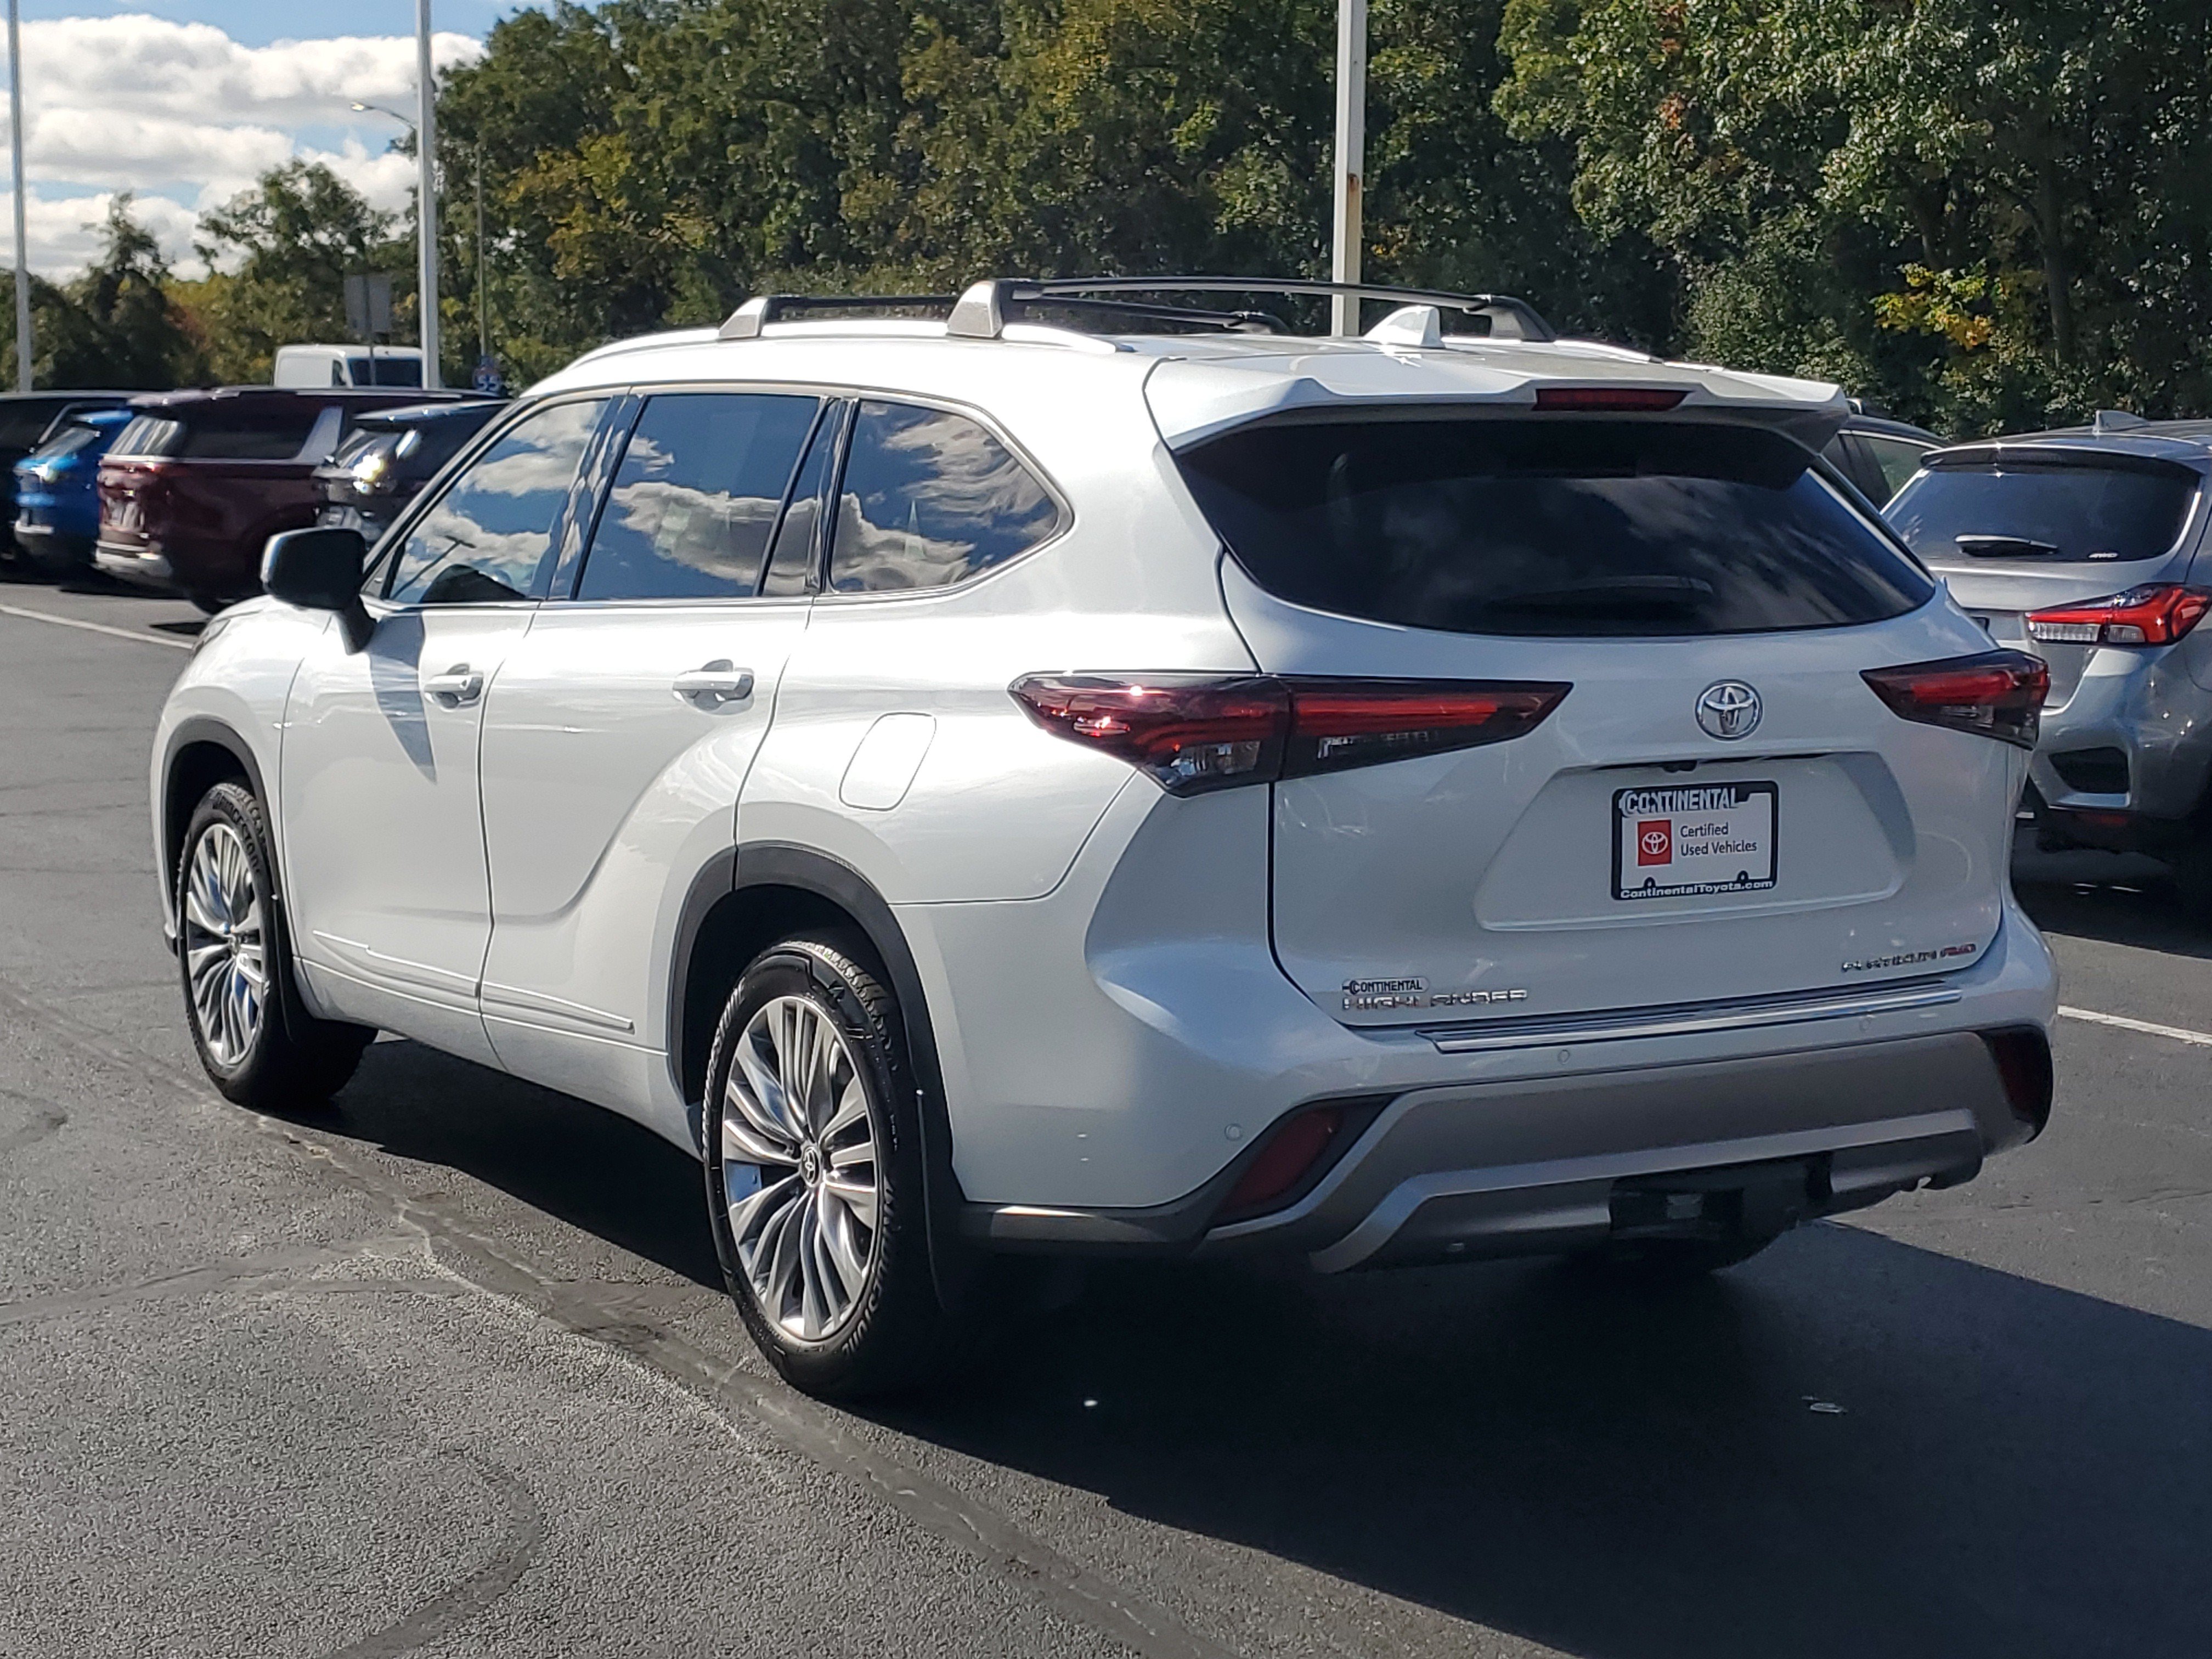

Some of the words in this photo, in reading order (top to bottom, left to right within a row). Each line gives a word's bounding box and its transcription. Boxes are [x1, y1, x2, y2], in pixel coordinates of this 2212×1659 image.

[1619, 788, 1737, 817] CONTINENTAL
[1680, 823, 1728, 838] Certified
[1680, 842, 1708, 856] Used
[1712, 839, 1757, 854] Vehicles
[1621, 881, 1773, 899] ContinentalToyota.com
[1342, 979, 1423, 995] CONTINENTAL
